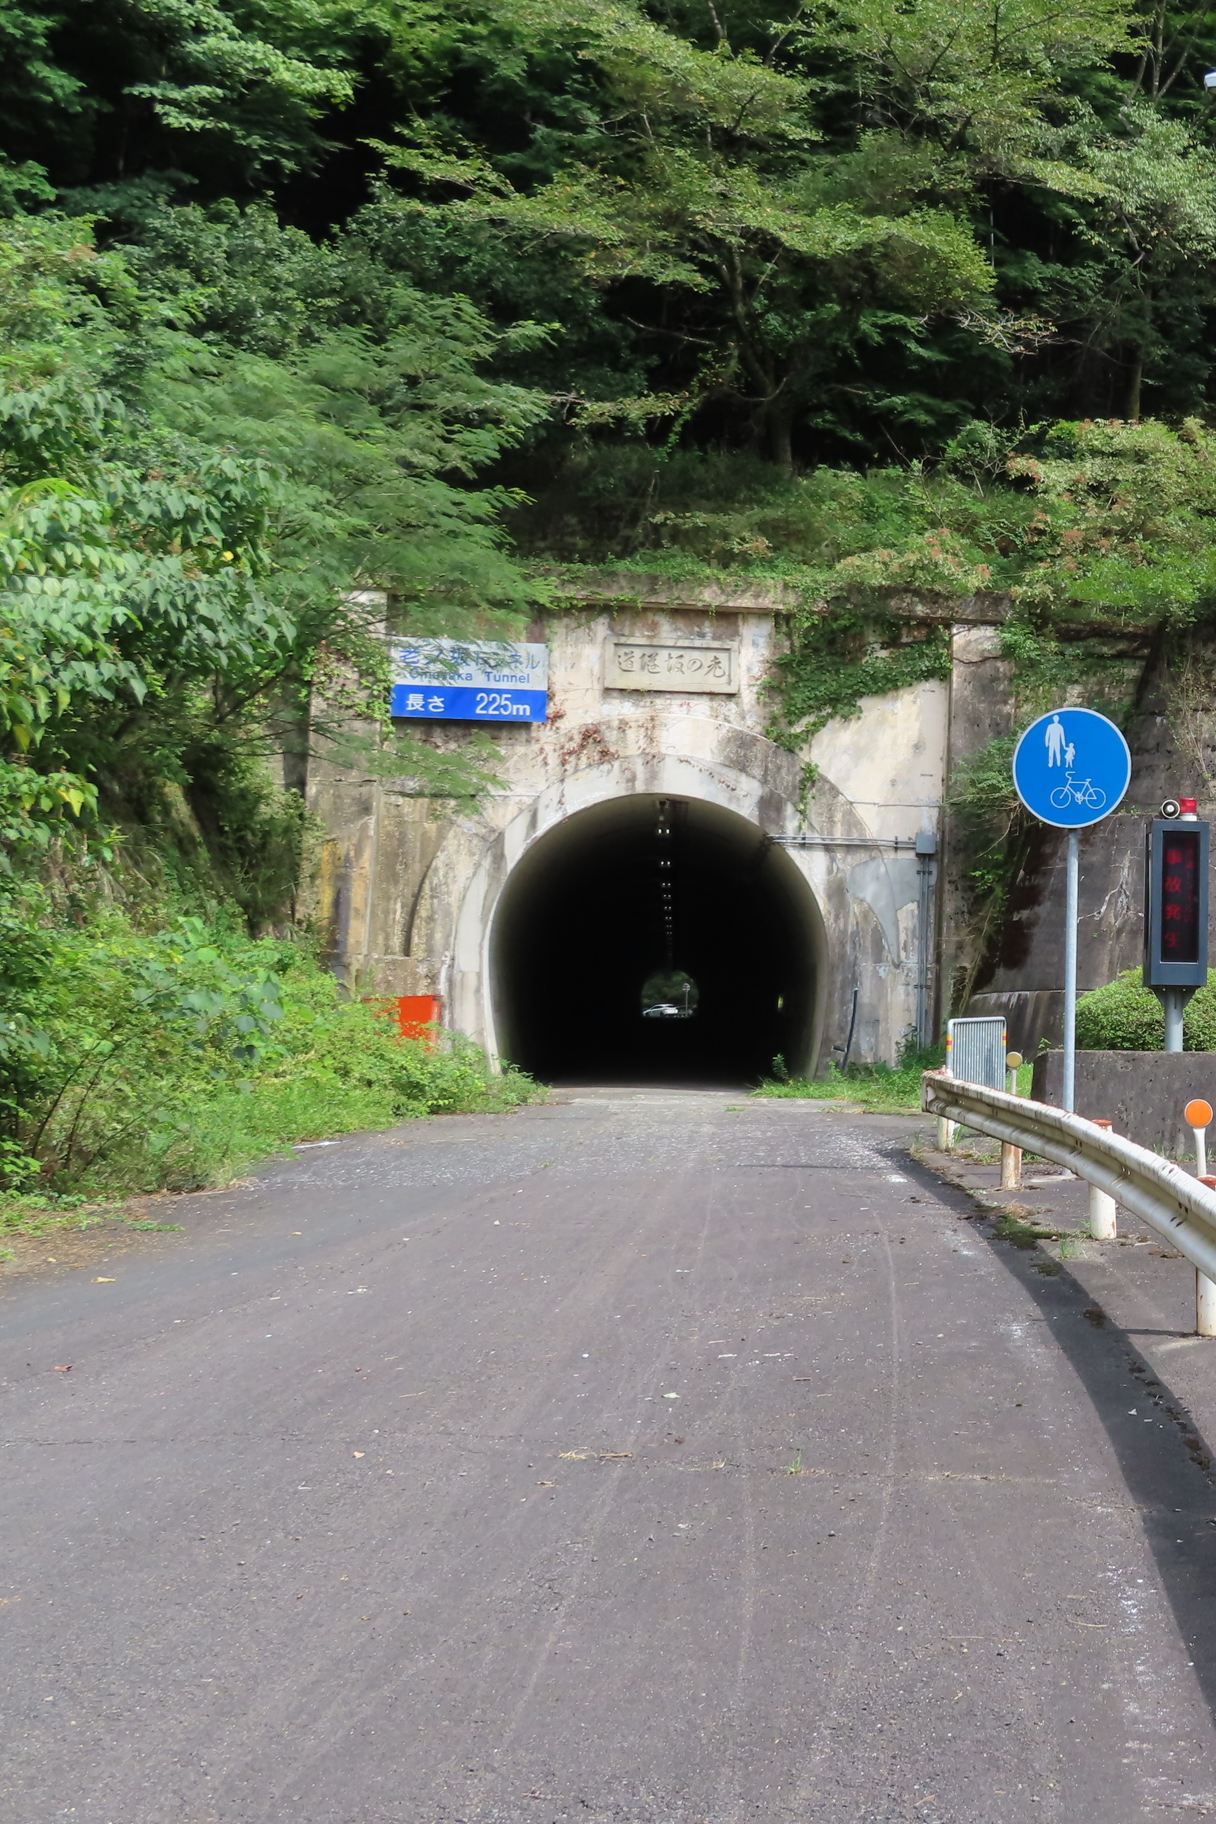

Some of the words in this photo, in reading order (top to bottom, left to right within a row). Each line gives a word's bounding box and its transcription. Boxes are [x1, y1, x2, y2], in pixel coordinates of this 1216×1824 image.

[485, 671, 531, 684] Tunnel
[406, 693, 446, 712] 長さ
[475, 692, 531, 716] 225m
